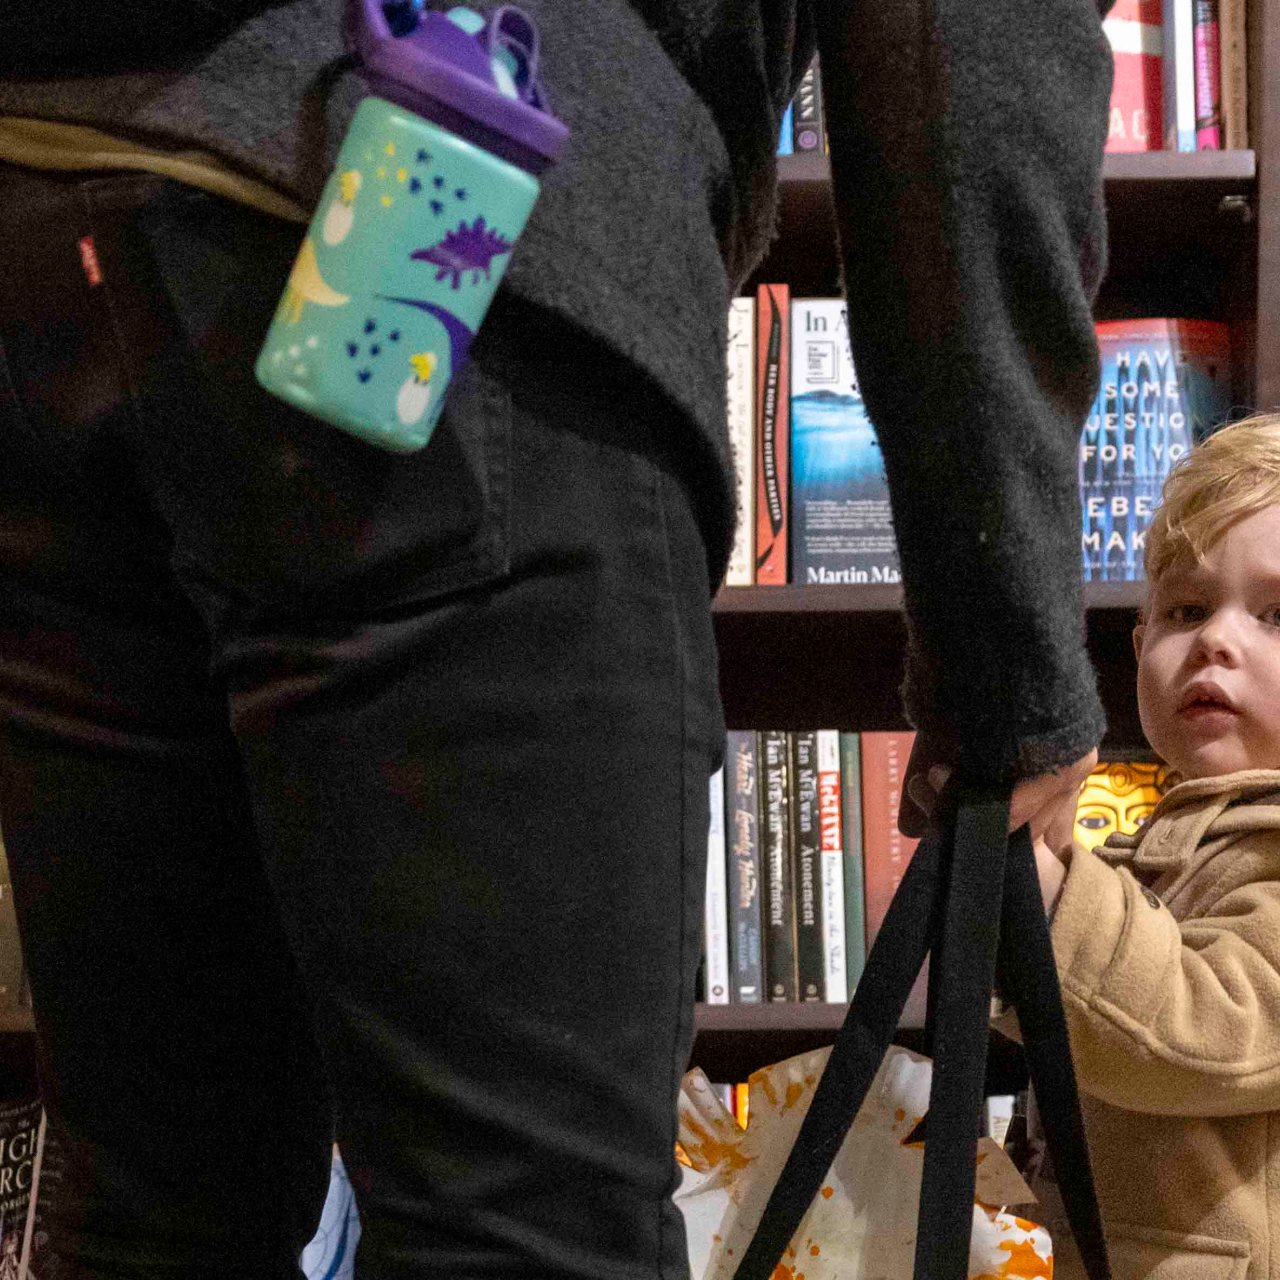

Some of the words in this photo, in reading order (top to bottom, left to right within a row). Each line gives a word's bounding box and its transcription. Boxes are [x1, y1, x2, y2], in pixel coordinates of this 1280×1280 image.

[805, 310, 828, 333] In
[1104, 380, 1180, 399] SOME
[806, 565, 864, 584] Martin
